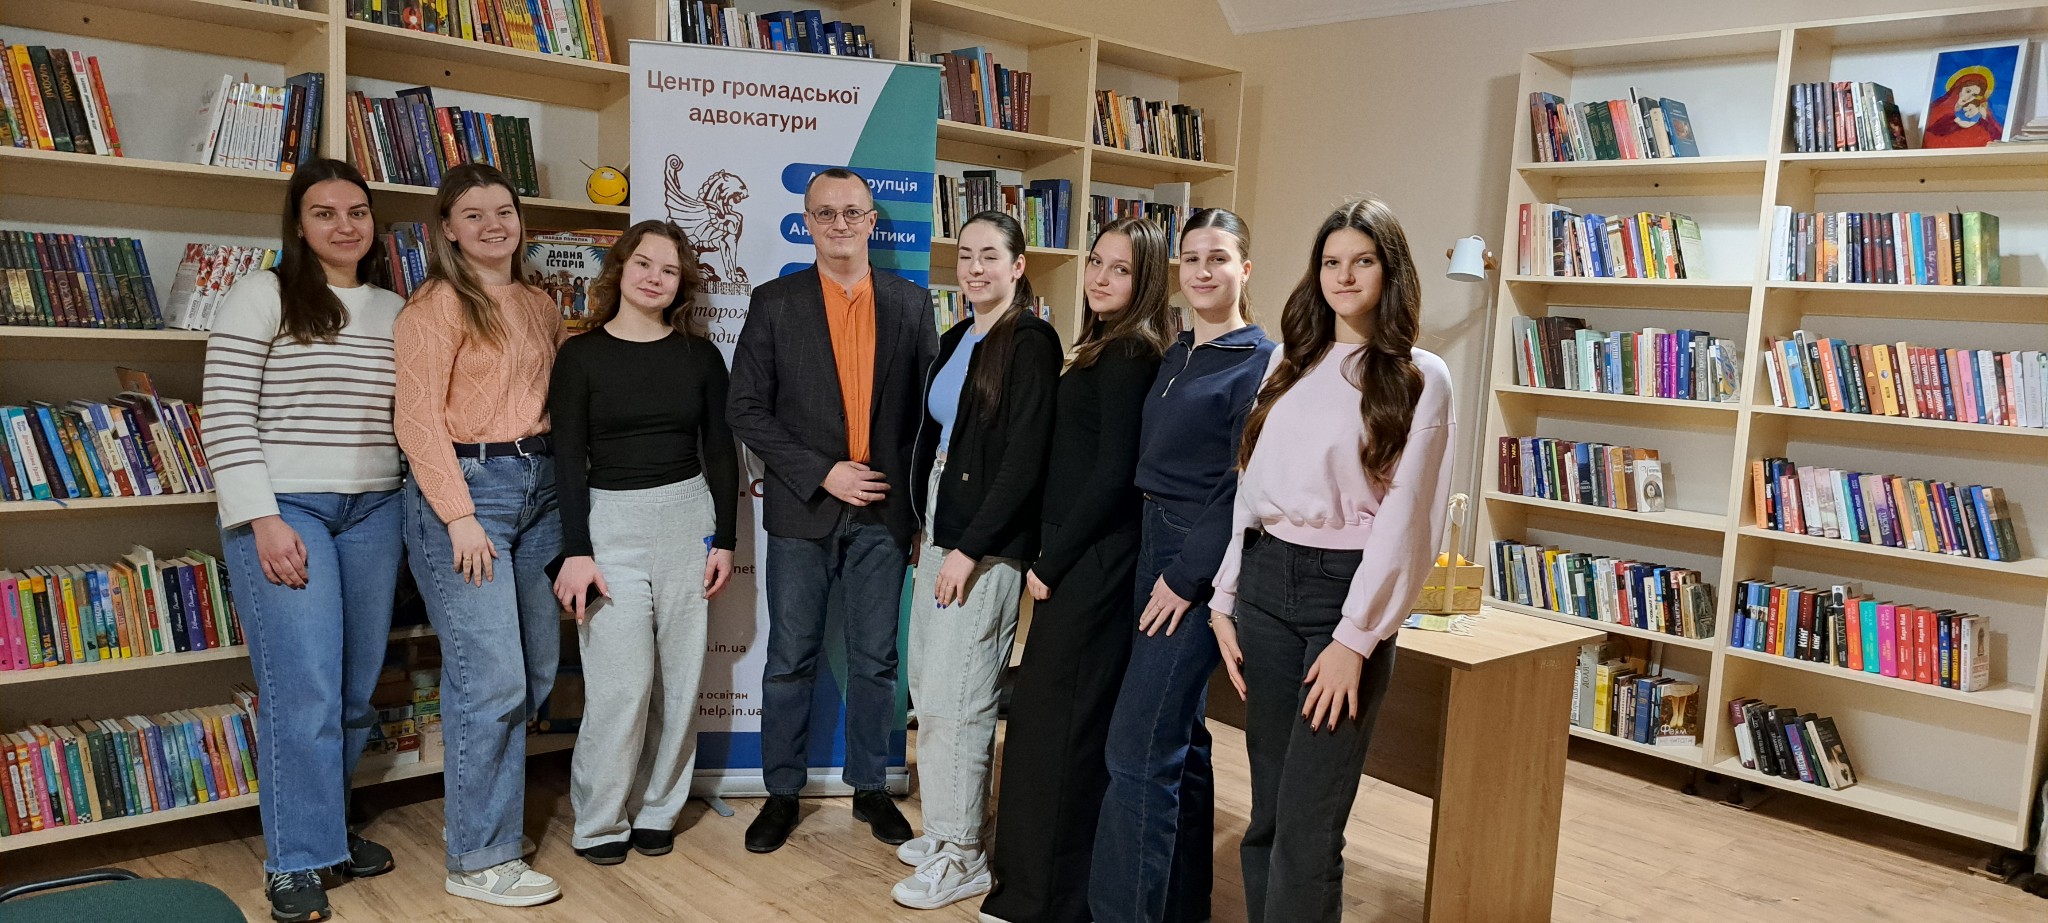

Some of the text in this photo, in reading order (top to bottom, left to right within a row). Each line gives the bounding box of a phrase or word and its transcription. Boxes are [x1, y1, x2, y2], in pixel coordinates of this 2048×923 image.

[648, 70, 860, 104] Центр громадської
[688, 108, 817, 132] адвокатури
[548, 250, 583, 260] ДАВНЯ
[546, 260, 584, 268] ІСТОРІЯ
[733, 563, 755, 574] net
[707, 641, 746, 653] .in.ua
[708, 690, 748, 700] освітян
[699, 704, 763, 718] help.in.ua
